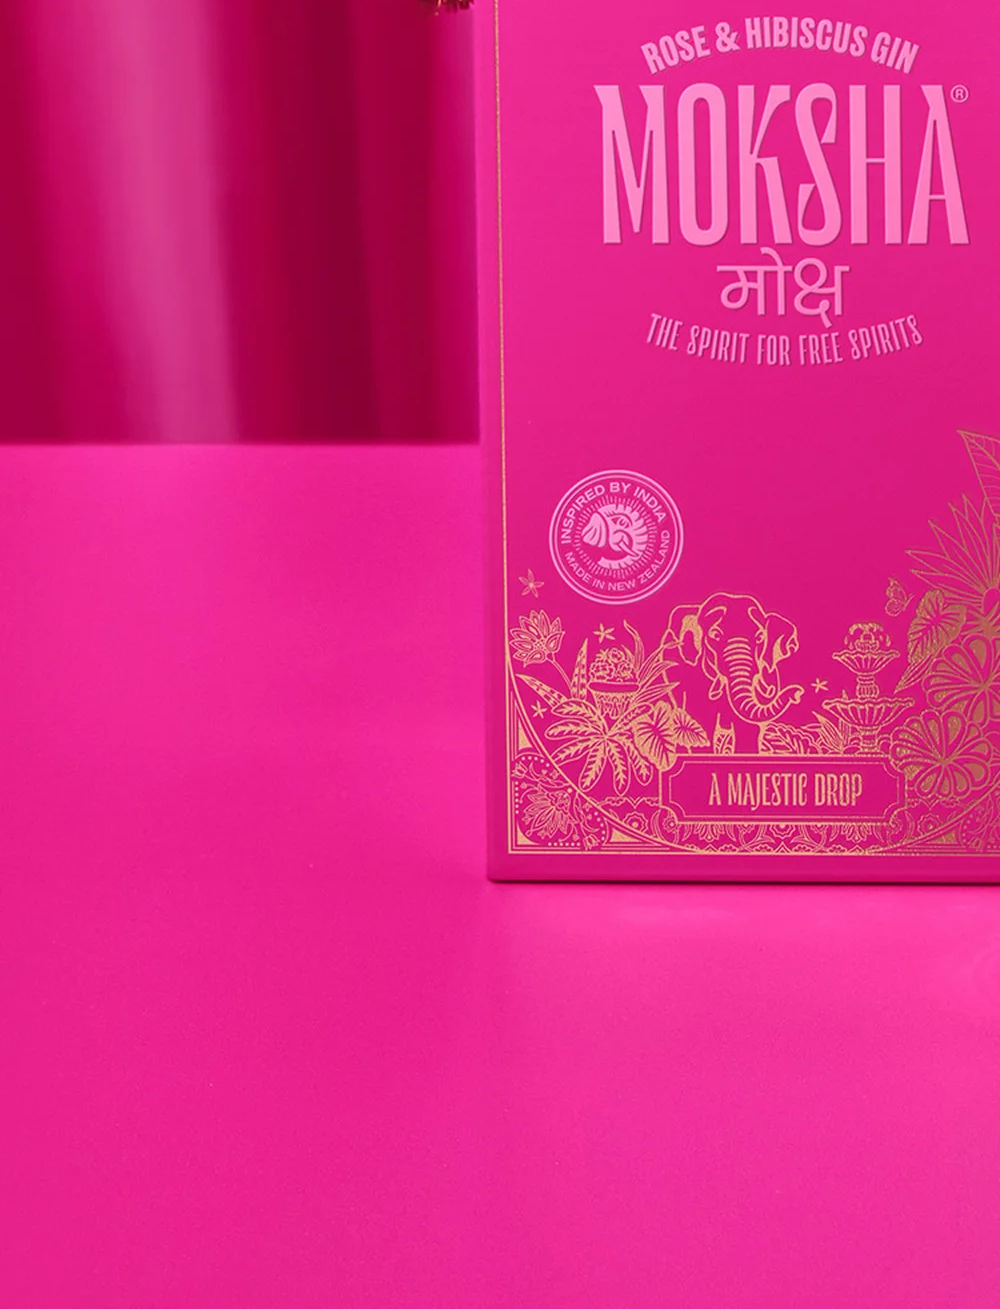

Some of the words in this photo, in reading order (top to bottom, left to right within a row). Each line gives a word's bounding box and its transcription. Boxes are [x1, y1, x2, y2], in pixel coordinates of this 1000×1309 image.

[641, 25, 711, 75] ROSE
[715, 22, 740, 54] &
[745, 16, 868, 57] HIBISCUS
[871, 31, 919, 74] GIN
[716, 246, 850, 328] मोक्ष
[646, 313, 683, 351] THE
[687, 325, 750, 364] SPIRIT
[757, 334, 790, 366] FOR
[799, 331, 844, 365] FREE
[848, 314, 923, 359] SPIRITS
[561, 484, 606, 544] INSPIRED
[609, 482, 632, 493] BY
[633, 486, 667, 524] INDIA
[564, 551, 593, 583] MADE
[592, 578, 606, 590] IN
[607, 579, 636, 591] NEW
[637, 530, 671, 584] ZEALAND
[708, 772, 722, 806] A
[727, 772, 808, 811] MAJESTIC
[814, 772, 863, 807] DROP
